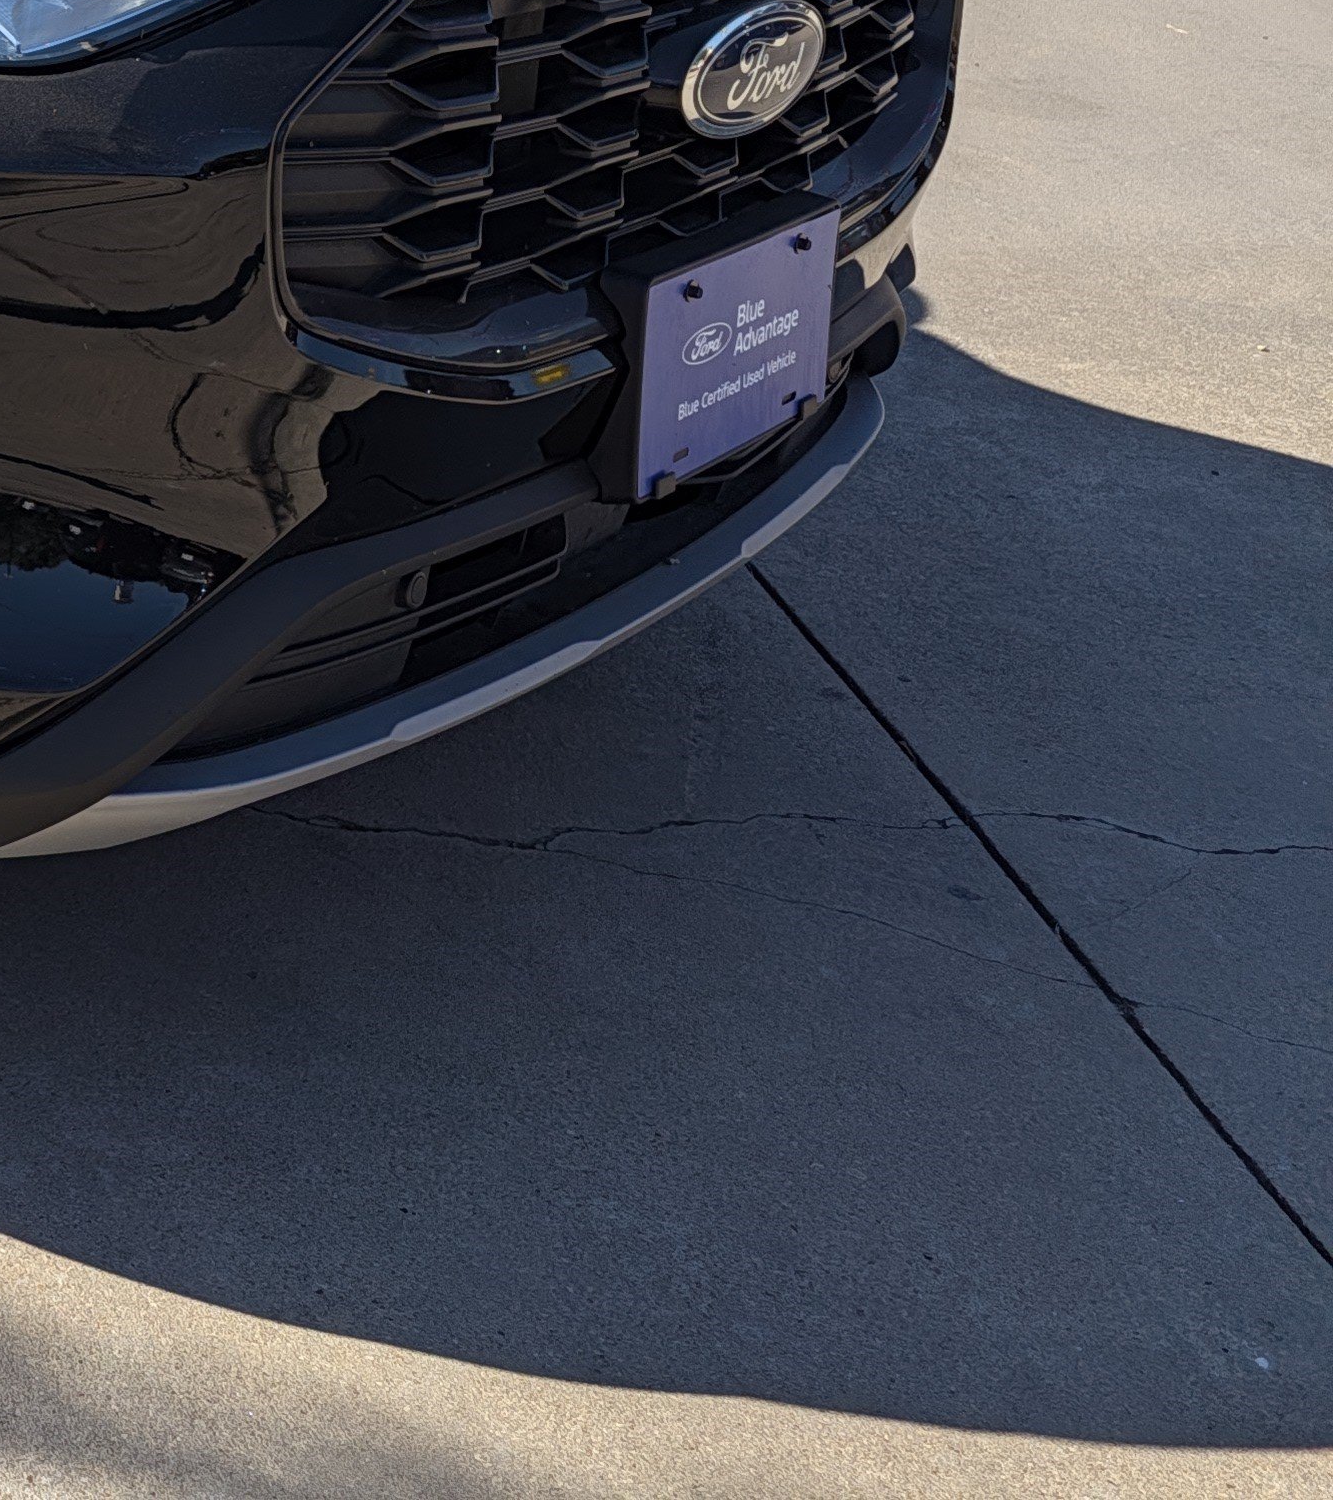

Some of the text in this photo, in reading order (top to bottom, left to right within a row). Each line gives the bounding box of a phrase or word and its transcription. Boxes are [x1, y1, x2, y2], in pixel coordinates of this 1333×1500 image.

[726, 32, 806, 111] Ford
[734, 308, 799, 356] Advantage
[736, 298, 765, 328] Blue
[690, 327, 725, 361] Ford
[677, 349, 797, 422] Blue Certified Used Vehicle
